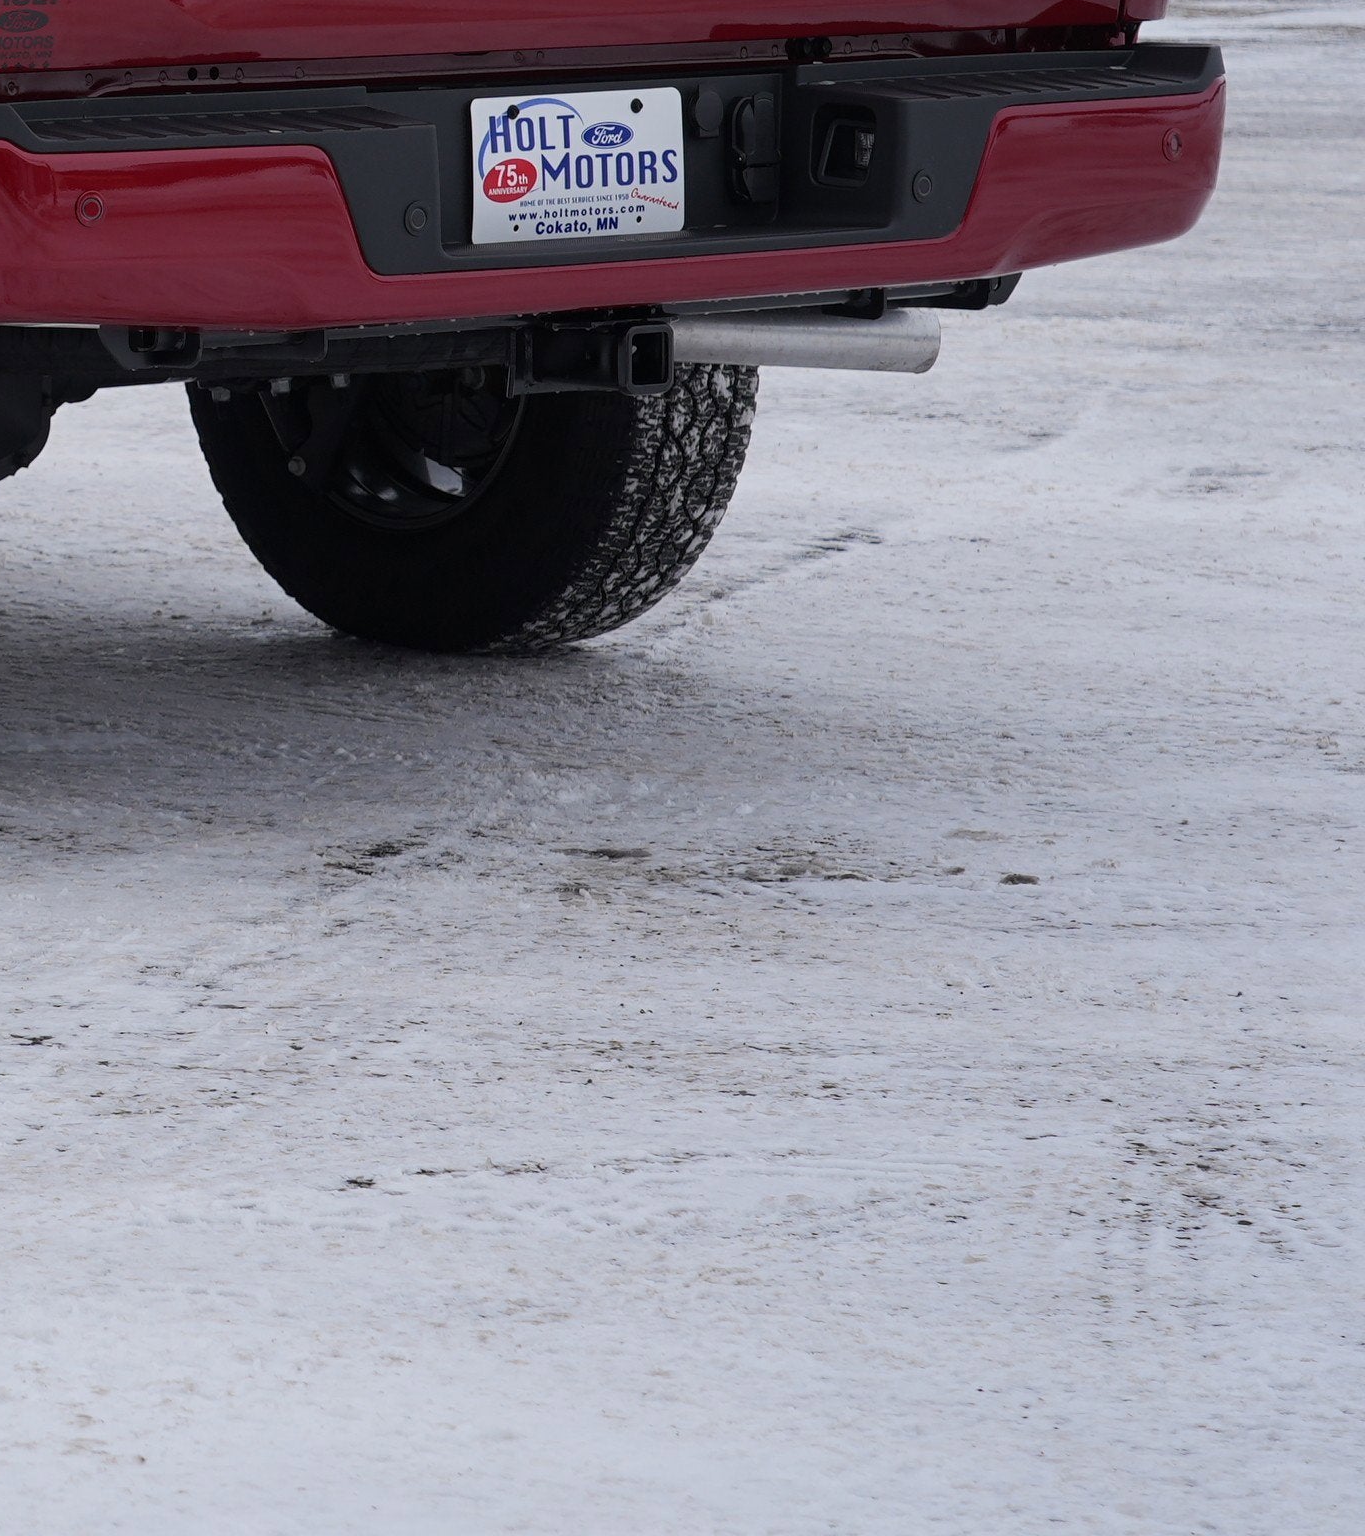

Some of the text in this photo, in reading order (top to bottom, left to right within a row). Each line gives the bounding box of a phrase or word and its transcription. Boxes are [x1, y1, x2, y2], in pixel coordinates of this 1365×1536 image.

[489, 115, 575, 154] HOLT
[591, 124, 624, 145] Ford
[494, 165, 529, 187] 75th
[541, 149, 678, 191] MOTORS
[488, 186, 528, 196] ANNIVERSARY
[520, 199, 536, 207] HOME
[557, 197, 571, 205] BEST
[572, 195, 595, 204] SERVICE
[596, 194, 613, 203] SINCE
[615, 193, 629, 201] 1950
[630, 187, 680, 210] Guaranteed
[508, 205, 646, 221] www.holtmotors.com
[535, 216, 619, 235] Cokato, MN
